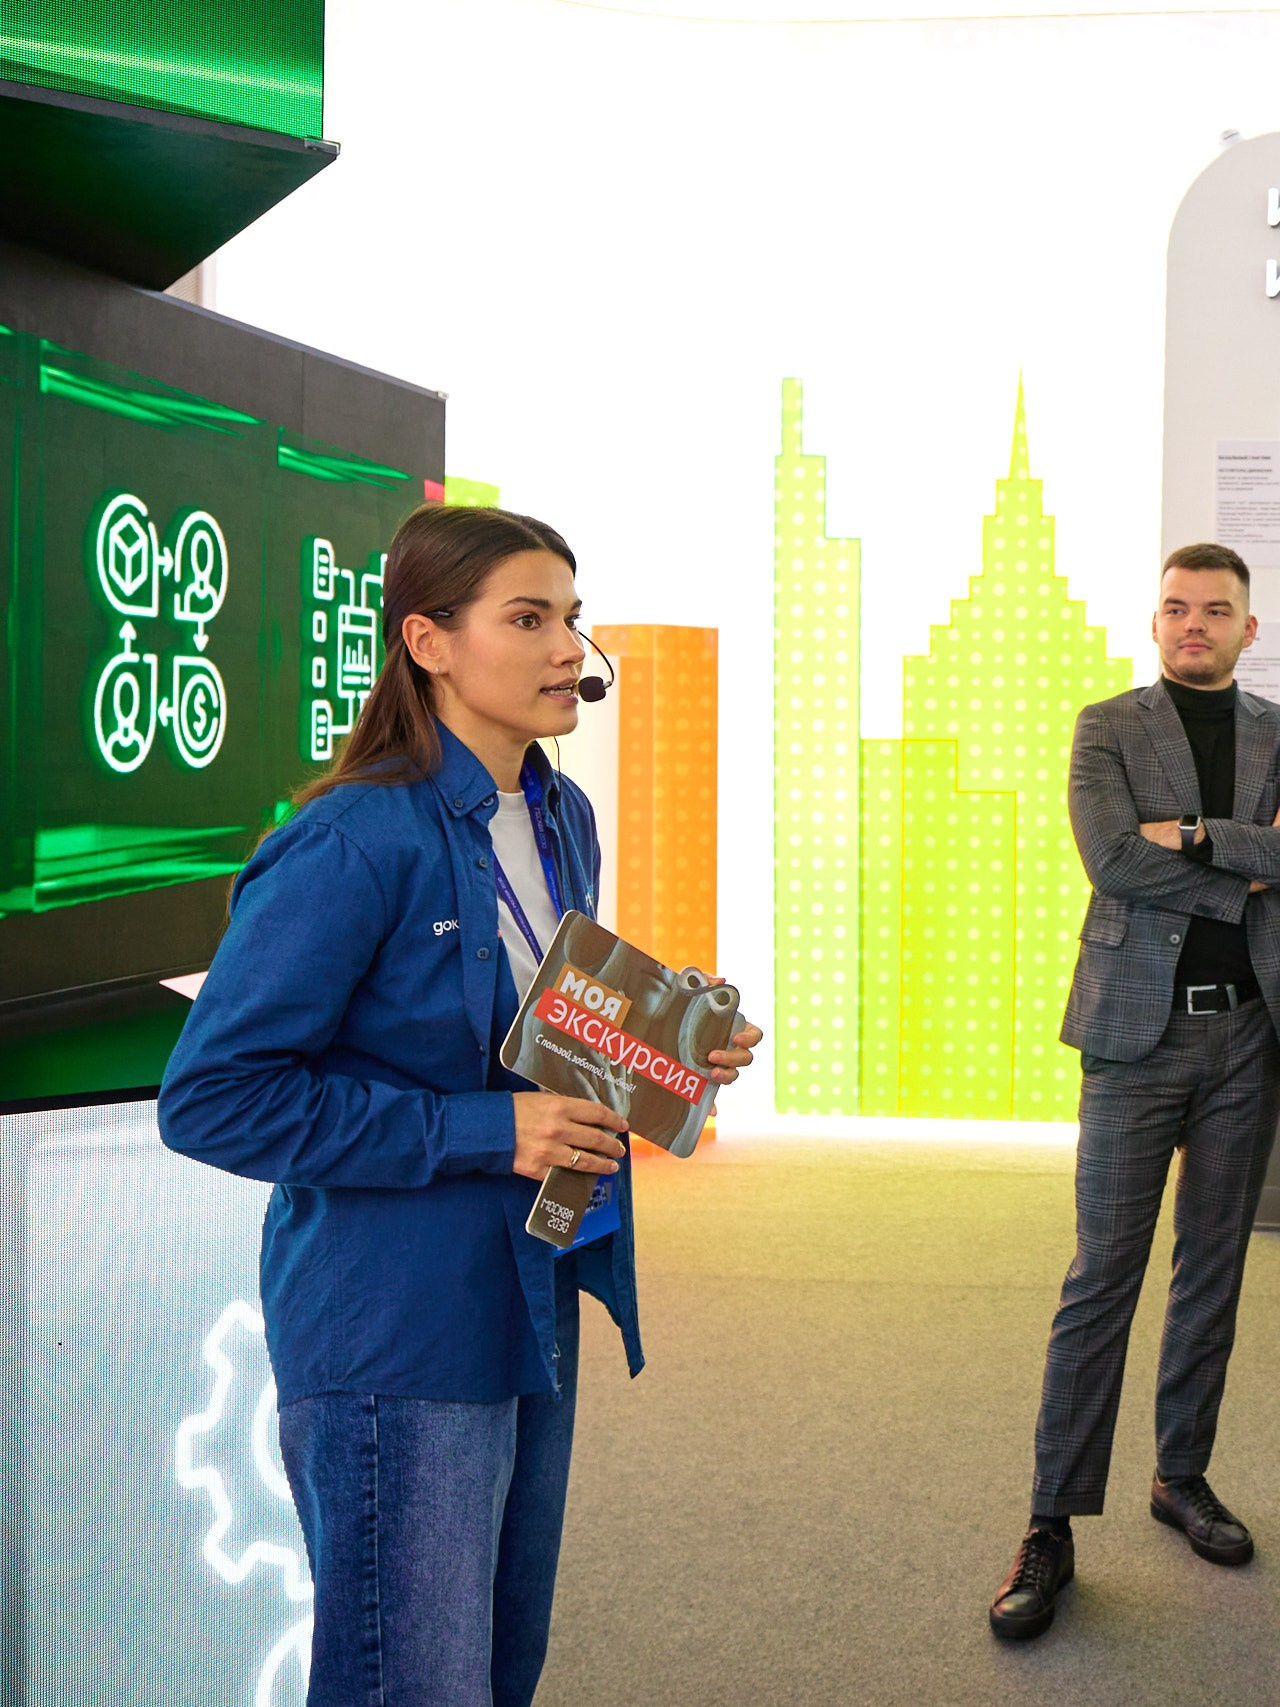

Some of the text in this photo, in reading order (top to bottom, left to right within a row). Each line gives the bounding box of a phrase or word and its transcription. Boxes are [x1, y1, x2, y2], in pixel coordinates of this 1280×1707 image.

[559, 970, 623, 1021] МОЯ
[535, 1034, 543, 1044] С
[541, 1040, 571, 1062] пользой,
[546, 998, 703, 1098] ЭКСКУРСИЯ
[540, 1198, 574, 1222] МОСКВА
[547, 1215, 570, 1233] 2030
